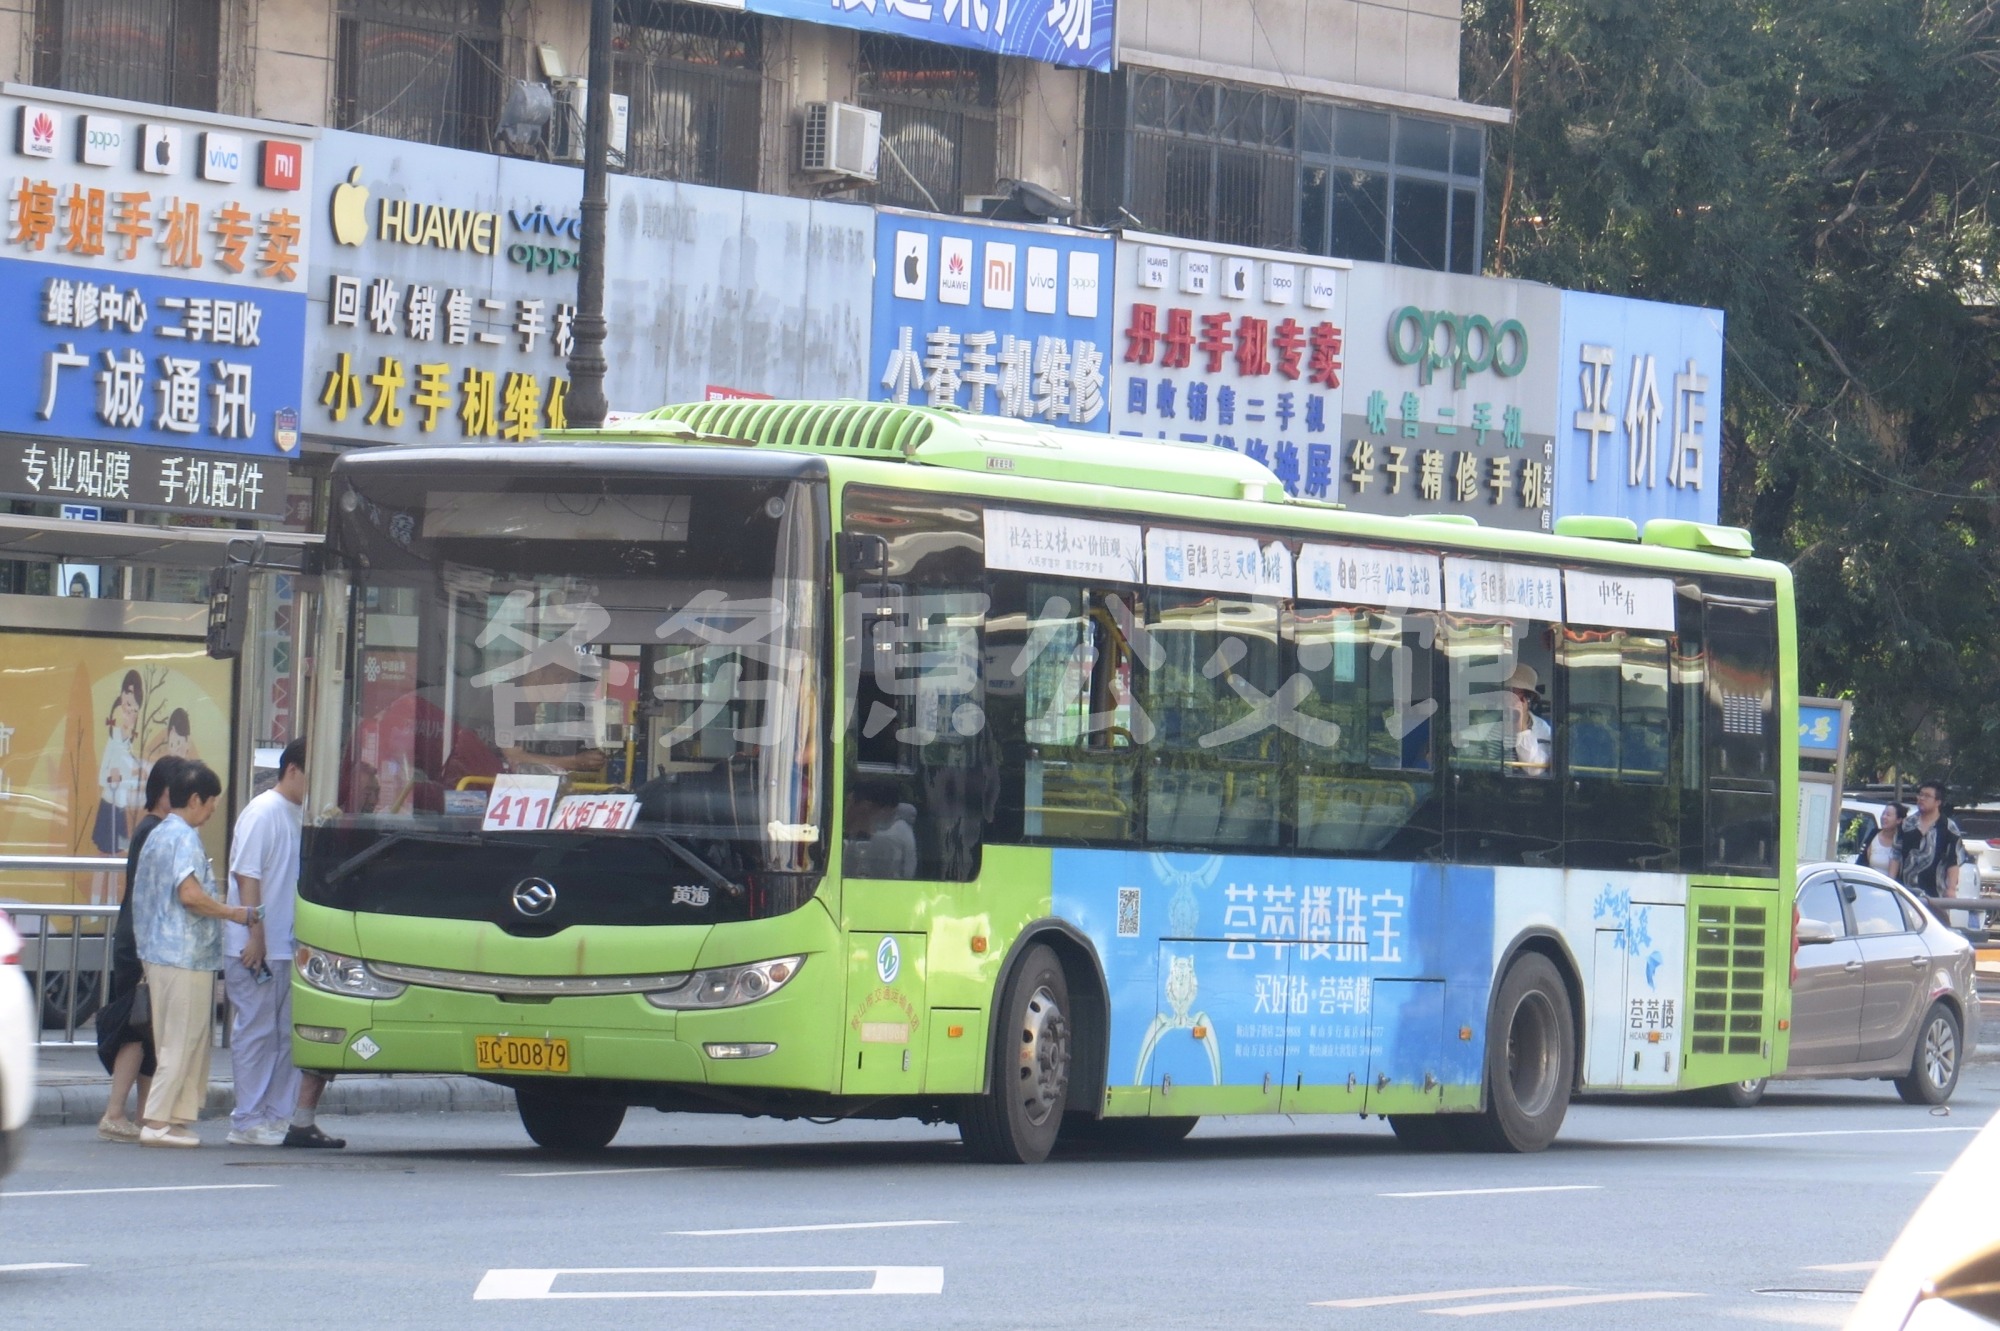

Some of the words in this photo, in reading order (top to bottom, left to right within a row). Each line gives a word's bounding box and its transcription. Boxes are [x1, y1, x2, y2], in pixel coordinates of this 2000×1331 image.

[8, 176, 305, 283] 婷姐手机专卖
[378, 198, 501, 256] HUAWEI
[508, 244, 580, 275] opp
[942, 279, 968, 291] HUAWEI
[1029, 273, 1055, 289] vivo
[1146, 257, 1169, 268] HUAWEI
[1188, 263, 1209, 274] HONOR
[45, 278, 148, 333] 维修中心
[159, 297, 262, 347] 二手回收
[1313, 284, 1334, 297] vivo
[881, 325, 1104, 423] 小春手机维修
[1124, 302, 1343, 389] 丹丹手机专卖
[37, 342, 256, 439] 广诚通讯
[1127, 376, 1326, 433] 回收销售二手机
[1367, 389, 1525, 449] 收售二手机
[1574, 342, 1710, 491] 平价店
[21, 443, 131, 500] 专业贴膜
[159, 456, 264, 511] 手机配件
[1350, 438, 1543, 509] 华子精修手机
[1541, 440, 1553, 529] 中光通信
[1009, 526, 1122, 559] 社会主义核心价值观
[488, 796, 550, 828] 411
[554, 801, 628, 830] 火炬广场
[1223, 883, 1404, 963] 荟萃楼珠宝
[1630, 998, 1675, 1029] 荟萃楼
[356, 1042, 376, 1053] LNG
